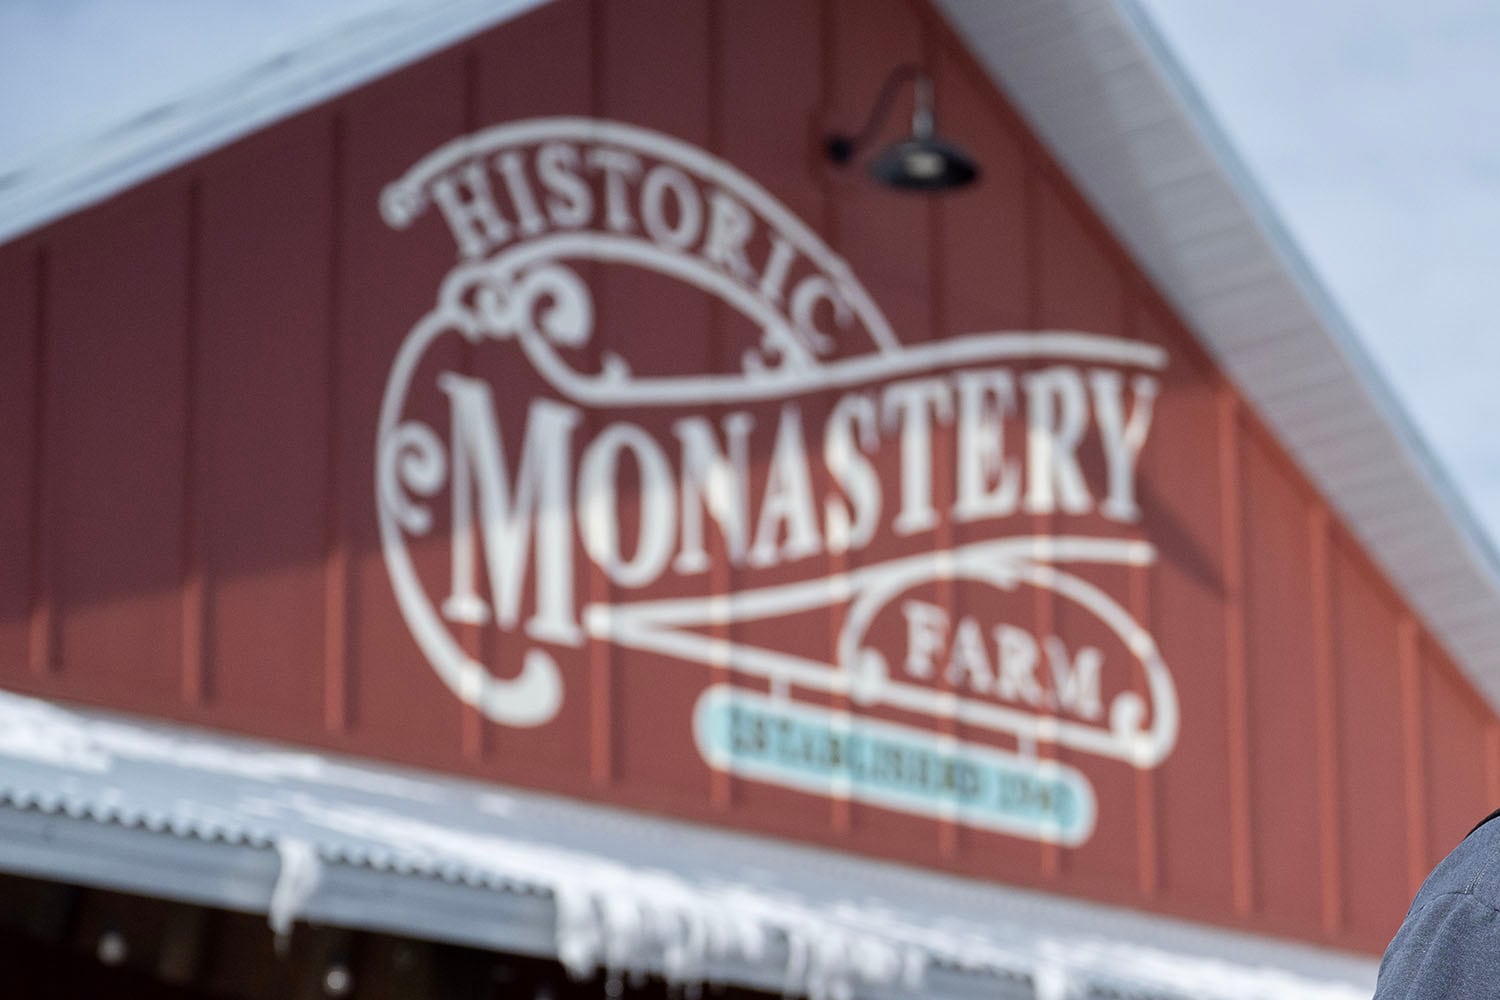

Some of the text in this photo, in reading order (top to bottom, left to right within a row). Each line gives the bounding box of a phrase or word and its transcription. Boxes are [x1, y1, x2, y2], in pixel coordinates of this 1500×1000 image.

[431, 145, 853, 353] HISTORIC
[438, 366, 1158, 646] MONASTERY
[902, 600, 1104, 721] FARM
